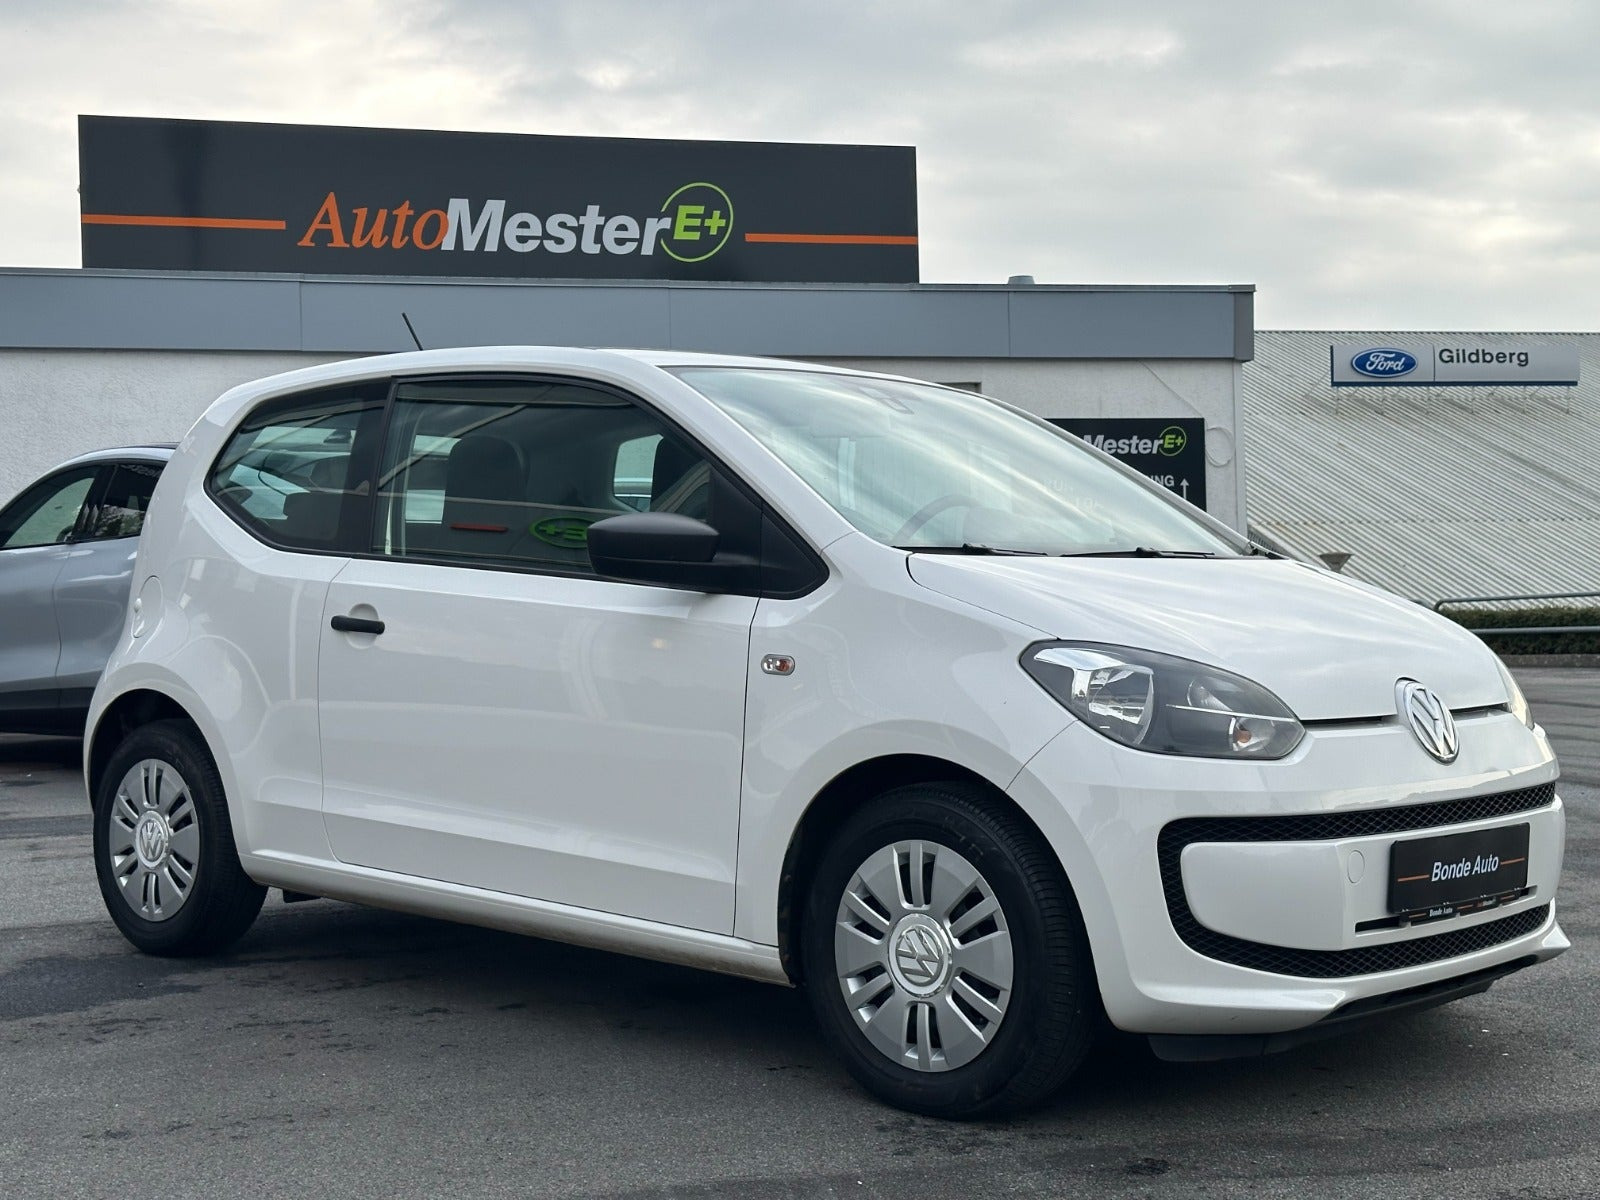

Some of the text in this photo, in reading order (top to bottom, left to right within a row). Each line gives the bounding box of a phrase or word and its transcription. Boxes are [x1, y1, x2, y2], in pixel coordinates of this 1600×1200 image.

[1366, 348, 1529, 372] Ford Gildberg
[1431, 853, 1499, 882] Bonde Auto
